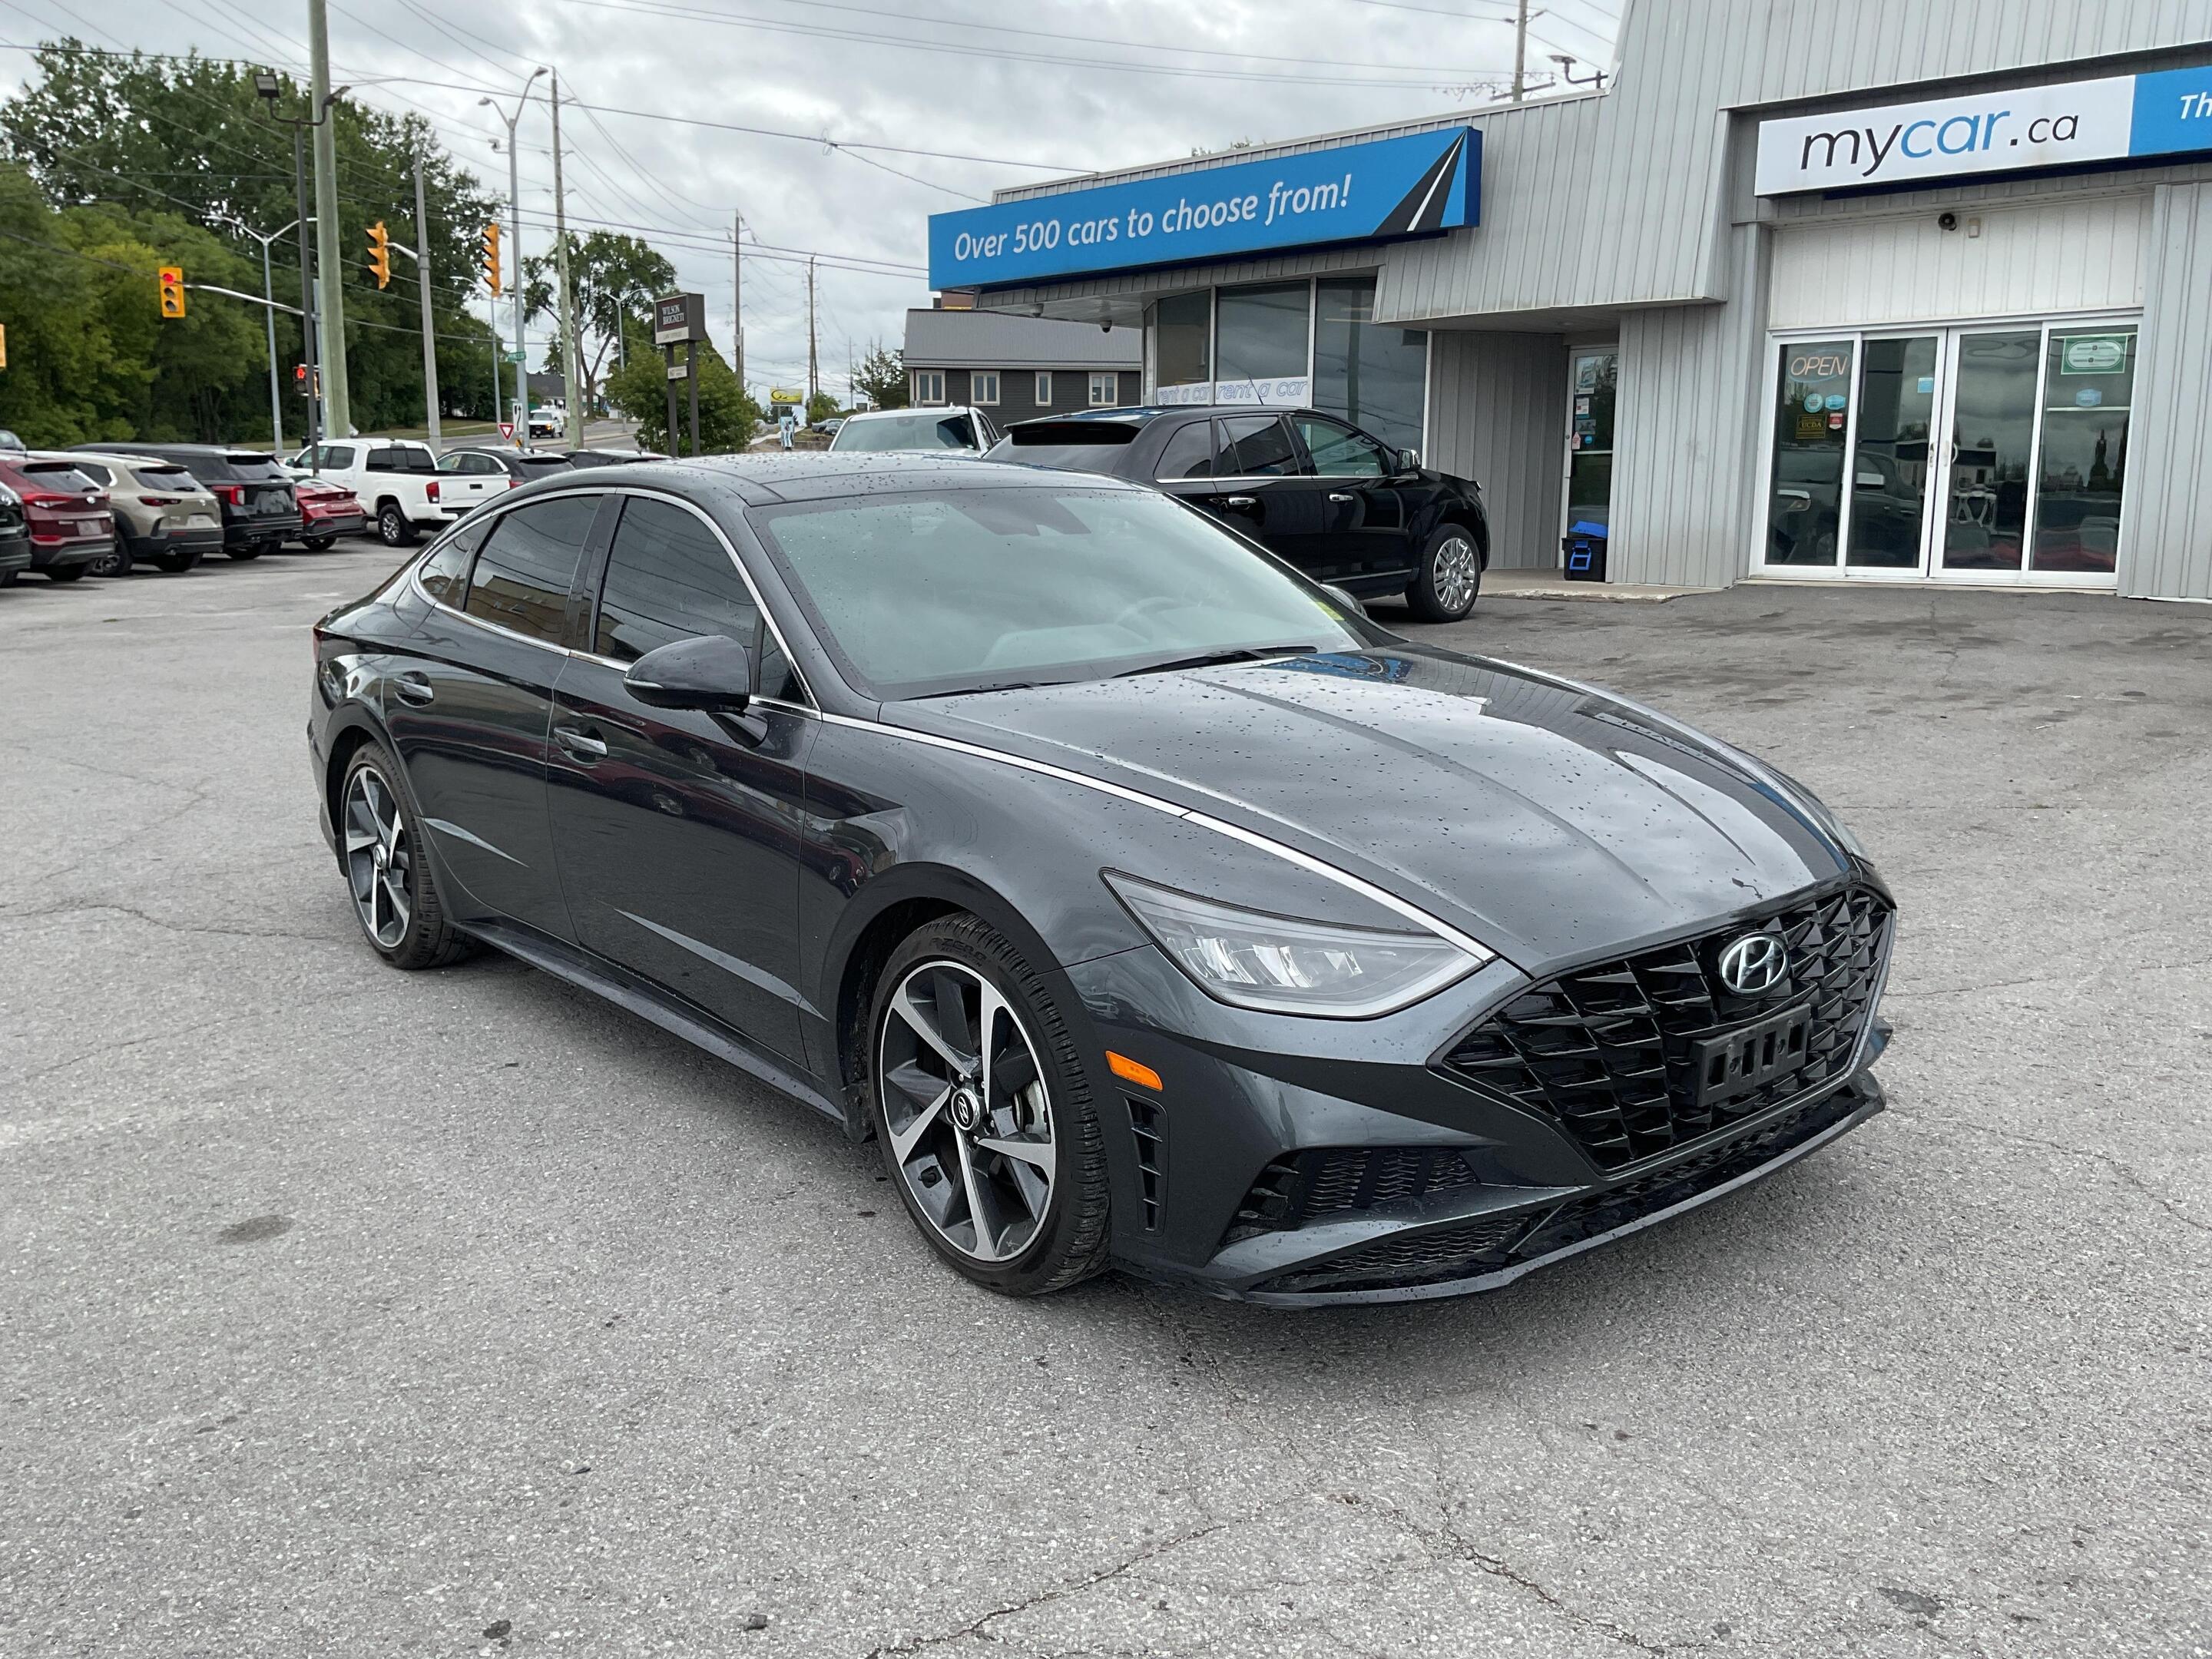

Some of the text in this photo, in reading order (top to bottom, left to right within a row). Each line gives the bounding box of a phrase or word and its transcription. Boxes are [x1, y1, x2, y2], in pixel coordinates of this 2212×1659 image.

[2180, 91, 2212, 120] Th
[955, 174, 1352, 261] Over 500 cars to choose from!
[1790, 356, 1848, 376] OPEN
[1158, 386, 1179, 404] rent
[1181, 388, 1190, 402] a
[1216, 380, 1308, 400] rent a car
